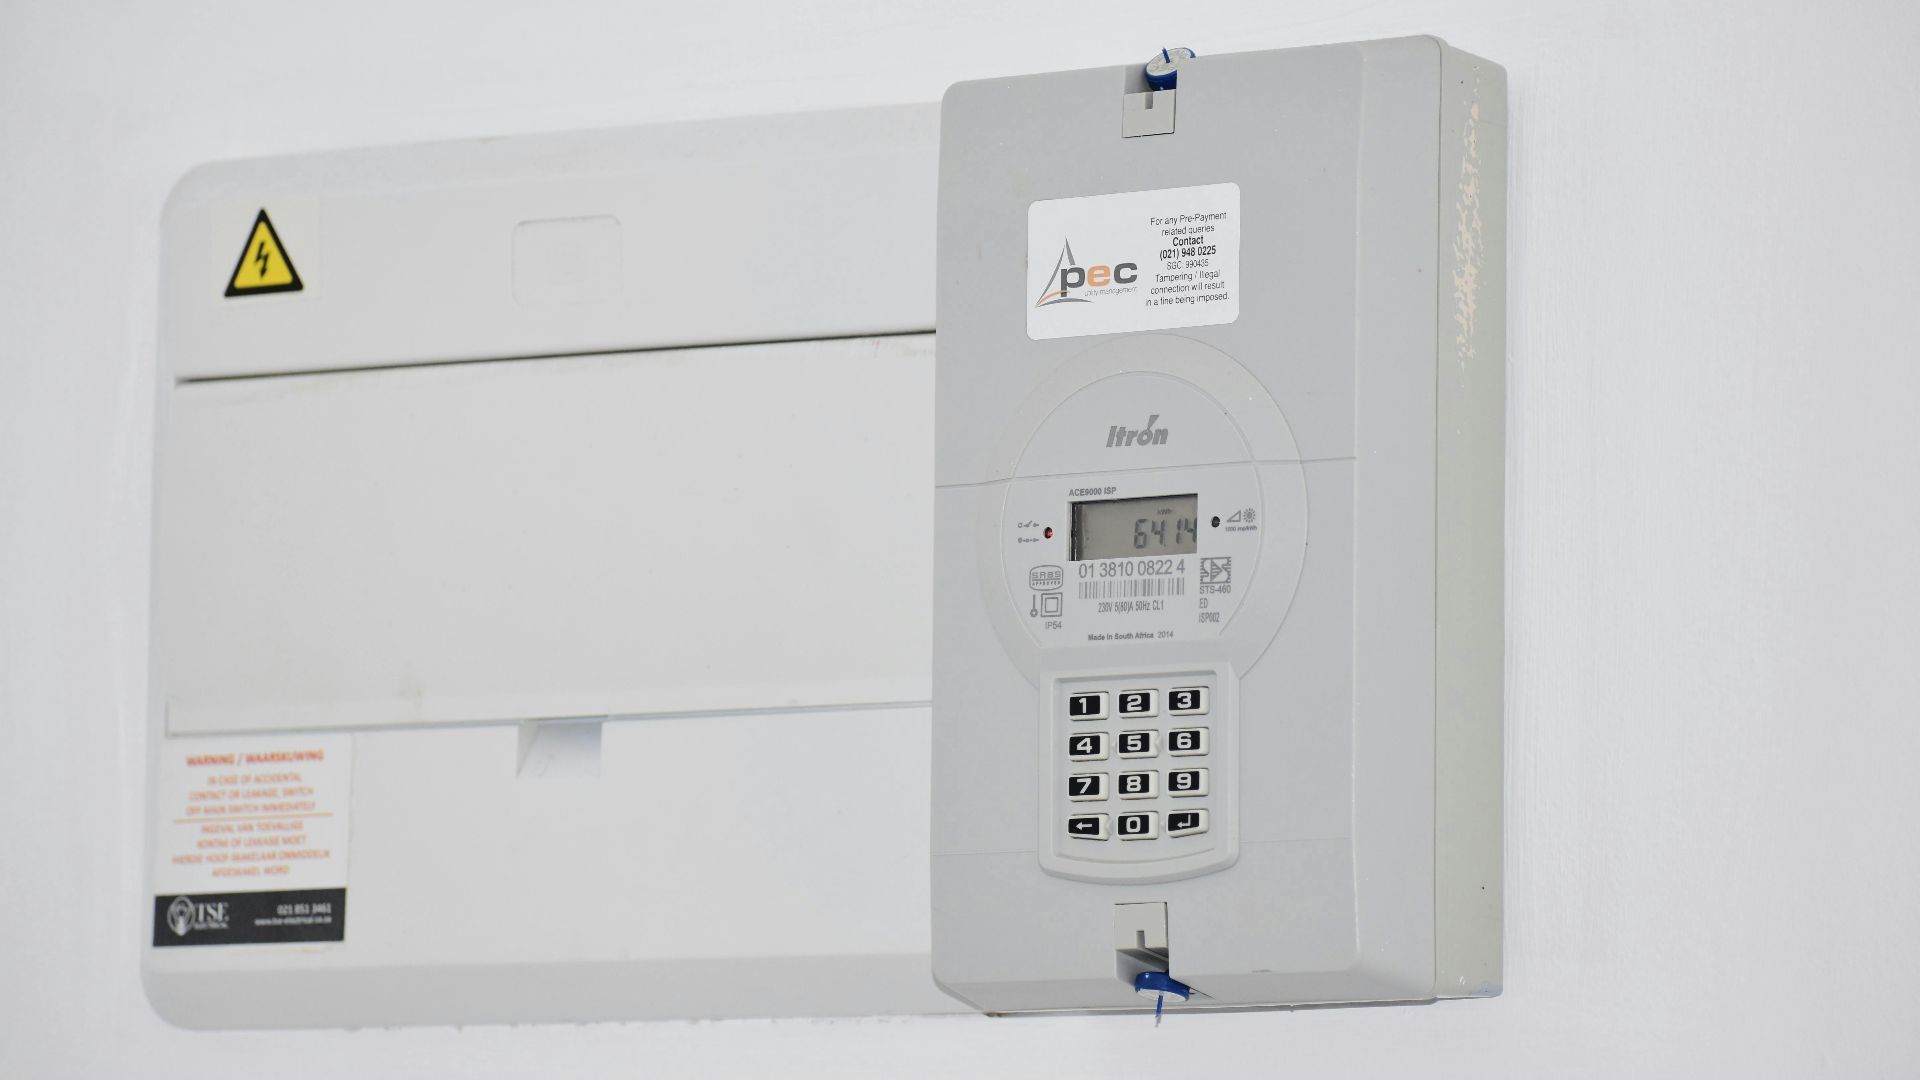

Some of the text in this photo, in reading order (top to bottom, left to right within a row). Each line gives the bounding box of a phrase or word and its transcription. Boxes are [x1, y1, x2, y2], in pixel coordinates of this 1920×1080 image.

[1150, 212, 1227, 226] For any Pre-Payment
[1161, 225, 1215, 236] related queries
[1172, 235, 1204, 247] Contact
[1159, 245, 1217, 261] (021) 948 0225
[1185, 258, 1209, 269] 990435
[1060, 262, 1138, 298] pec
[1155, 271, 1193, 283] Tampering
[1150, 281, 1225, 295] connection will result
[1145, 298, 1152, 307] in
[1160, 296, 1174, 305] fine
[1175, 295, 1195, 305] being
[1196, 292, 1230, 304] imposed.
[1069, 486, 1117, 497] ACE9000 ISP
[1032, 570, 1061, 579] SABS
[1078, 558, 1185, 579] 01 3810 0822 4
[1199, 584, 1232, 595] STS-460
[1098, 602, 1113, 613] 230V
[1135, 600, 1151, 612] 50Hz
[1199, 597, 1208, 609] ED
[1045, 620, 1062, 630] IP54
[1198, 612, 1220, 624] ISP002
[1088, 633, 1106, 641] Made
[1114, 632, 1134, 640] South
[1135, 631, 1154, 639] Africa
[1157, 630, 1174, 639] 2014
[1078, 697, 1087, 714] 1
[1126, 694, 1142, 711] 2
[1177, 692, 1192, 709] 3
[1076, 737, 1093, 754] 4
[1126, 735, 1142, 751] 5
[1176, 732, 1191, 749] 6
[187, 754, 234, 767] WARNING
[1076, 778, 1092, 794] 7
[1126, 775, 1141, 792] 8
[1177, 773, 1192, 790] 9
[1125, 816, 1141, 833] 0
